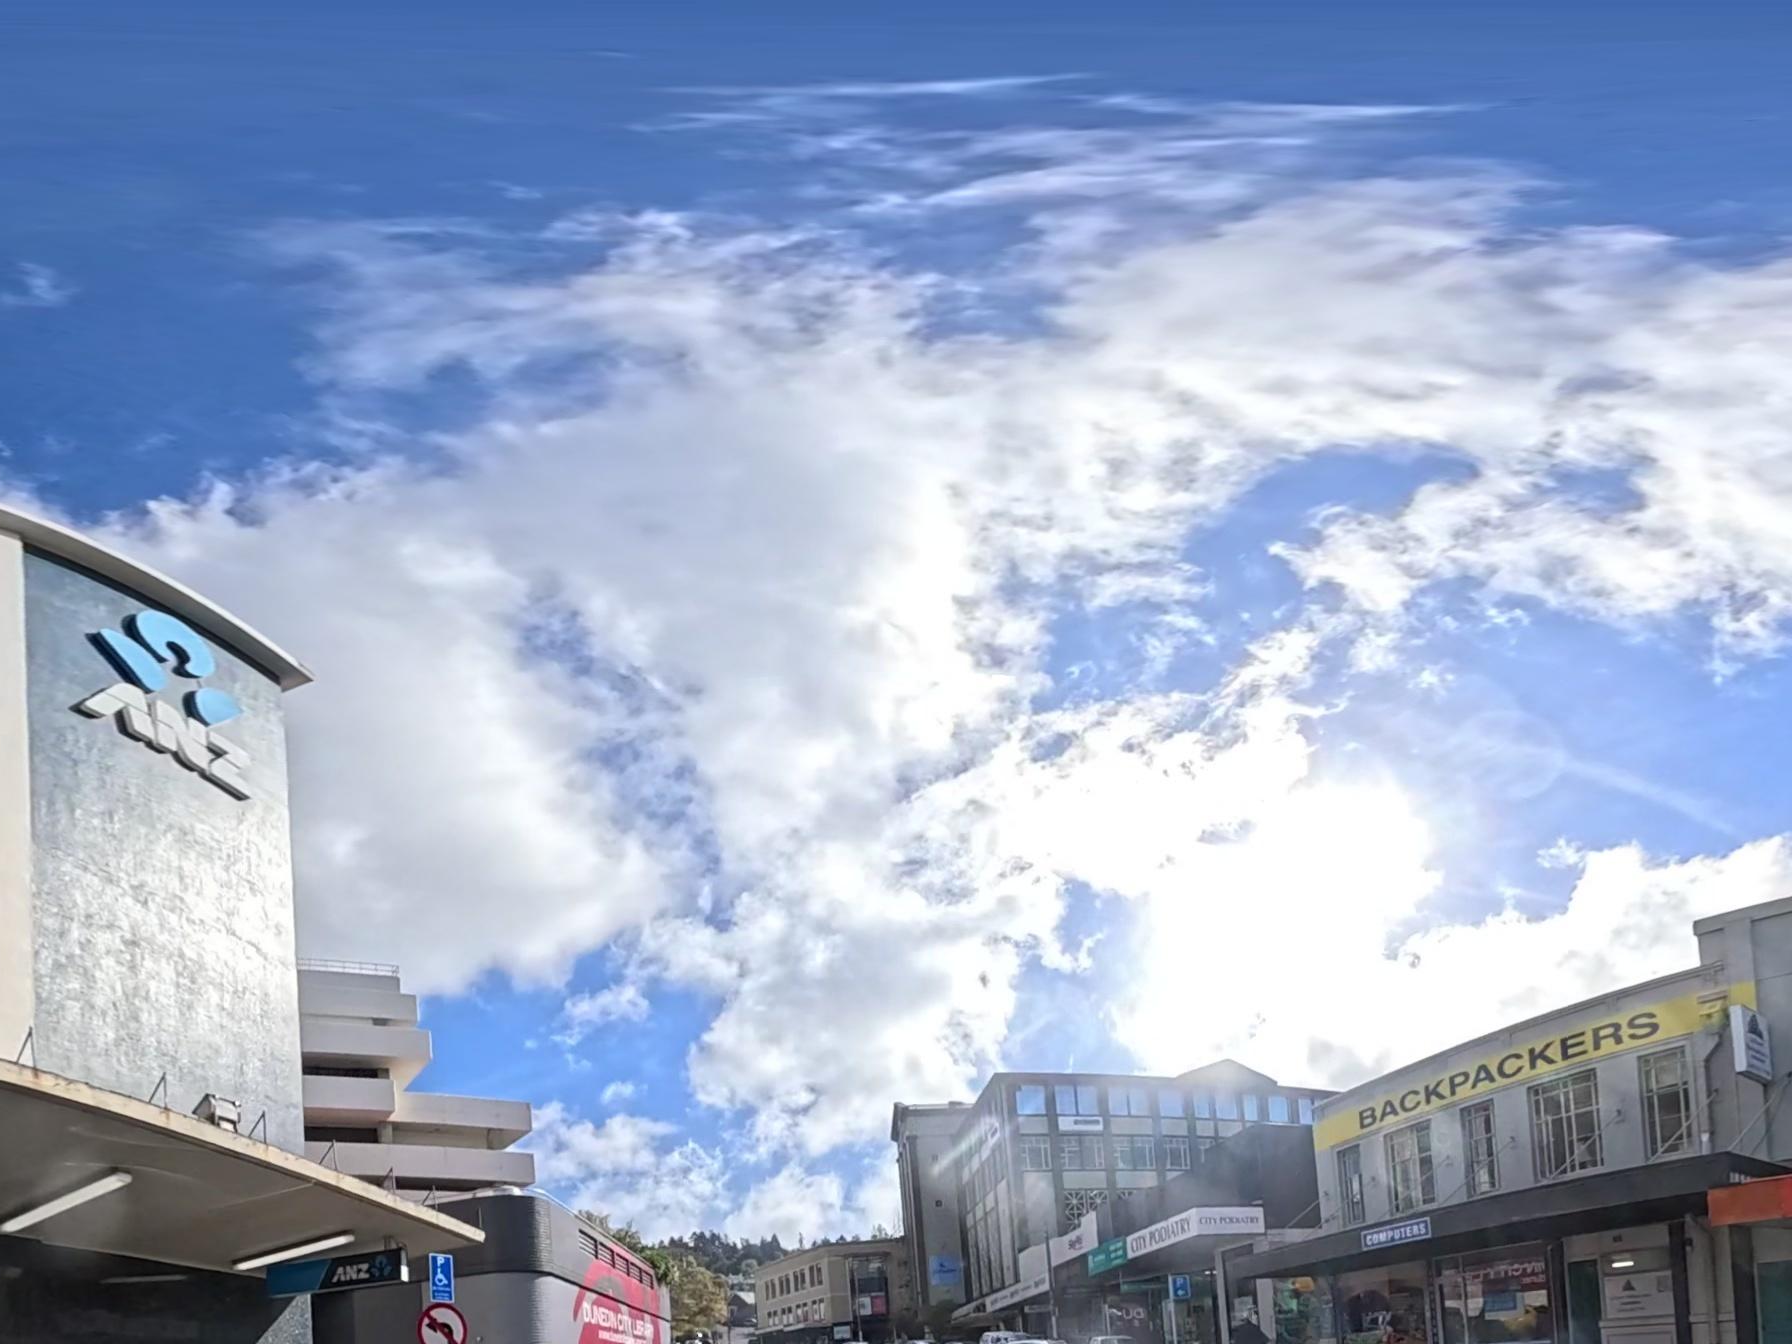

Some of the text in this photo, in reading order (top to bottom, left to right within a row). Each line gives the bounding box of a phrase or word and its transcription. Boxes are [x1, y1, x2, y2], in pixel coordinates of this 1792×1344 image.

[78, 682, 252, 800] ANZ
[1358, 1012, 1661, 1130] BACKPACKERS
[1199, 1216, 1259, 1225] CITY PODIATRY
[1130, 1236, 1147, 1254] CITY
[1149, 1217, 1192, 1247] PODIATRY
[1365, 1222, 1427, 1246] COMPUTERS
[332, 1263, 370, 1283] ANZ
[437, 1256, 445, 1267] P
[582, 1301, 616, 1330] DUNEDIN
